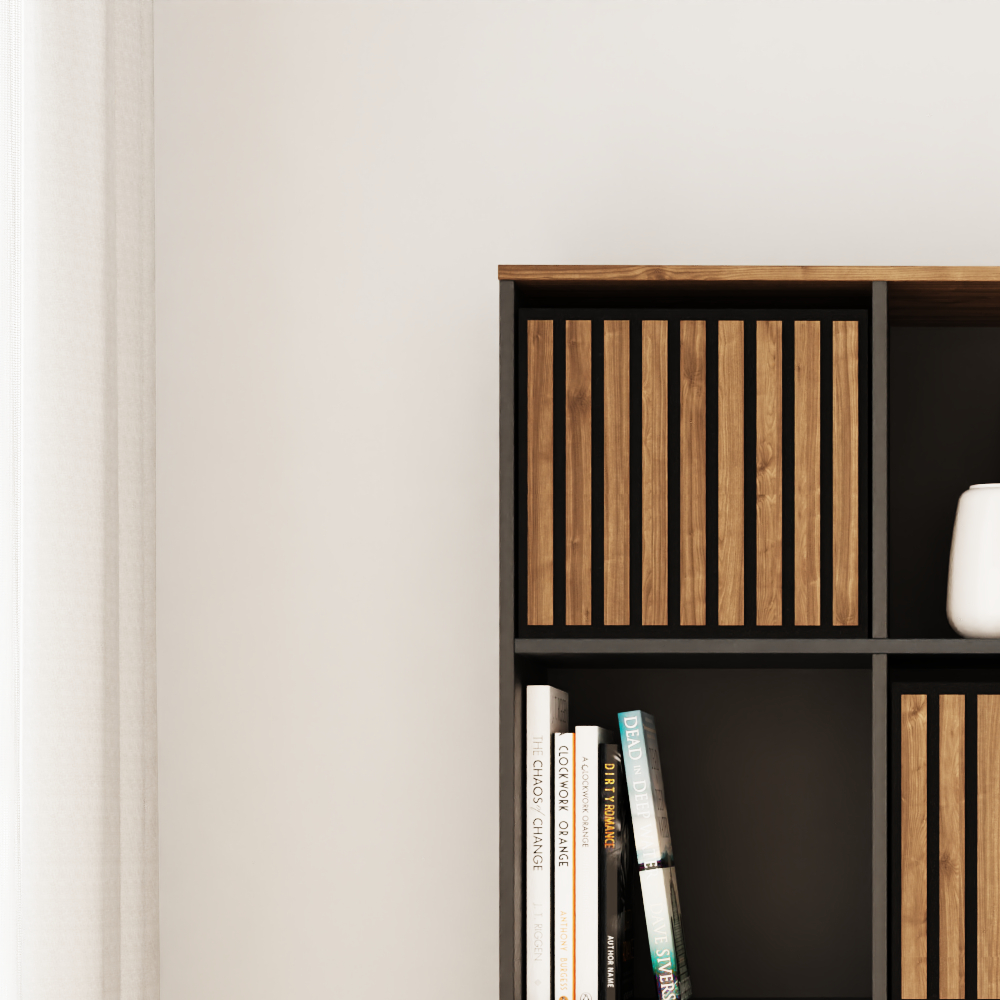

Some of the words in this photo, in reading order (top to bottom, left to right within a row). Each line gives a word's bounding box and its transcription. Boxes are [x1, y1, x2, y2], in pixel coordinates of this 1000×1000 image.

[532, 735, 544, 756] THE
[623, 714, 643, 761] DEAD
[532, 759, 544, 804] CHAOS
[558, 745, 569, 812] CLOCKWORK
[581, 764, 589, 813] CLOCKWORK
[604, 763, 615, 802] DIRTY
[632, 779, 650, 820] DEEP
[532, 817, 544, 871] CHANGE
[558, 820, 569, 867] ORANGE
[581, 815, 589, 848] ORANGE
[604, 804, 615, 849] ROMANCE
[638, 822, 660, 878] WATER
[533, 923, 543, 961] RIGGEN
[559, 910, 569, 951] ANTHONY
[648, 902, 668, 945] DAVE
[606, 935, 615, 966] AUTHOR
[559, 957, 569, 991] BURGESS
[606, 966, 615, 989] NAME
